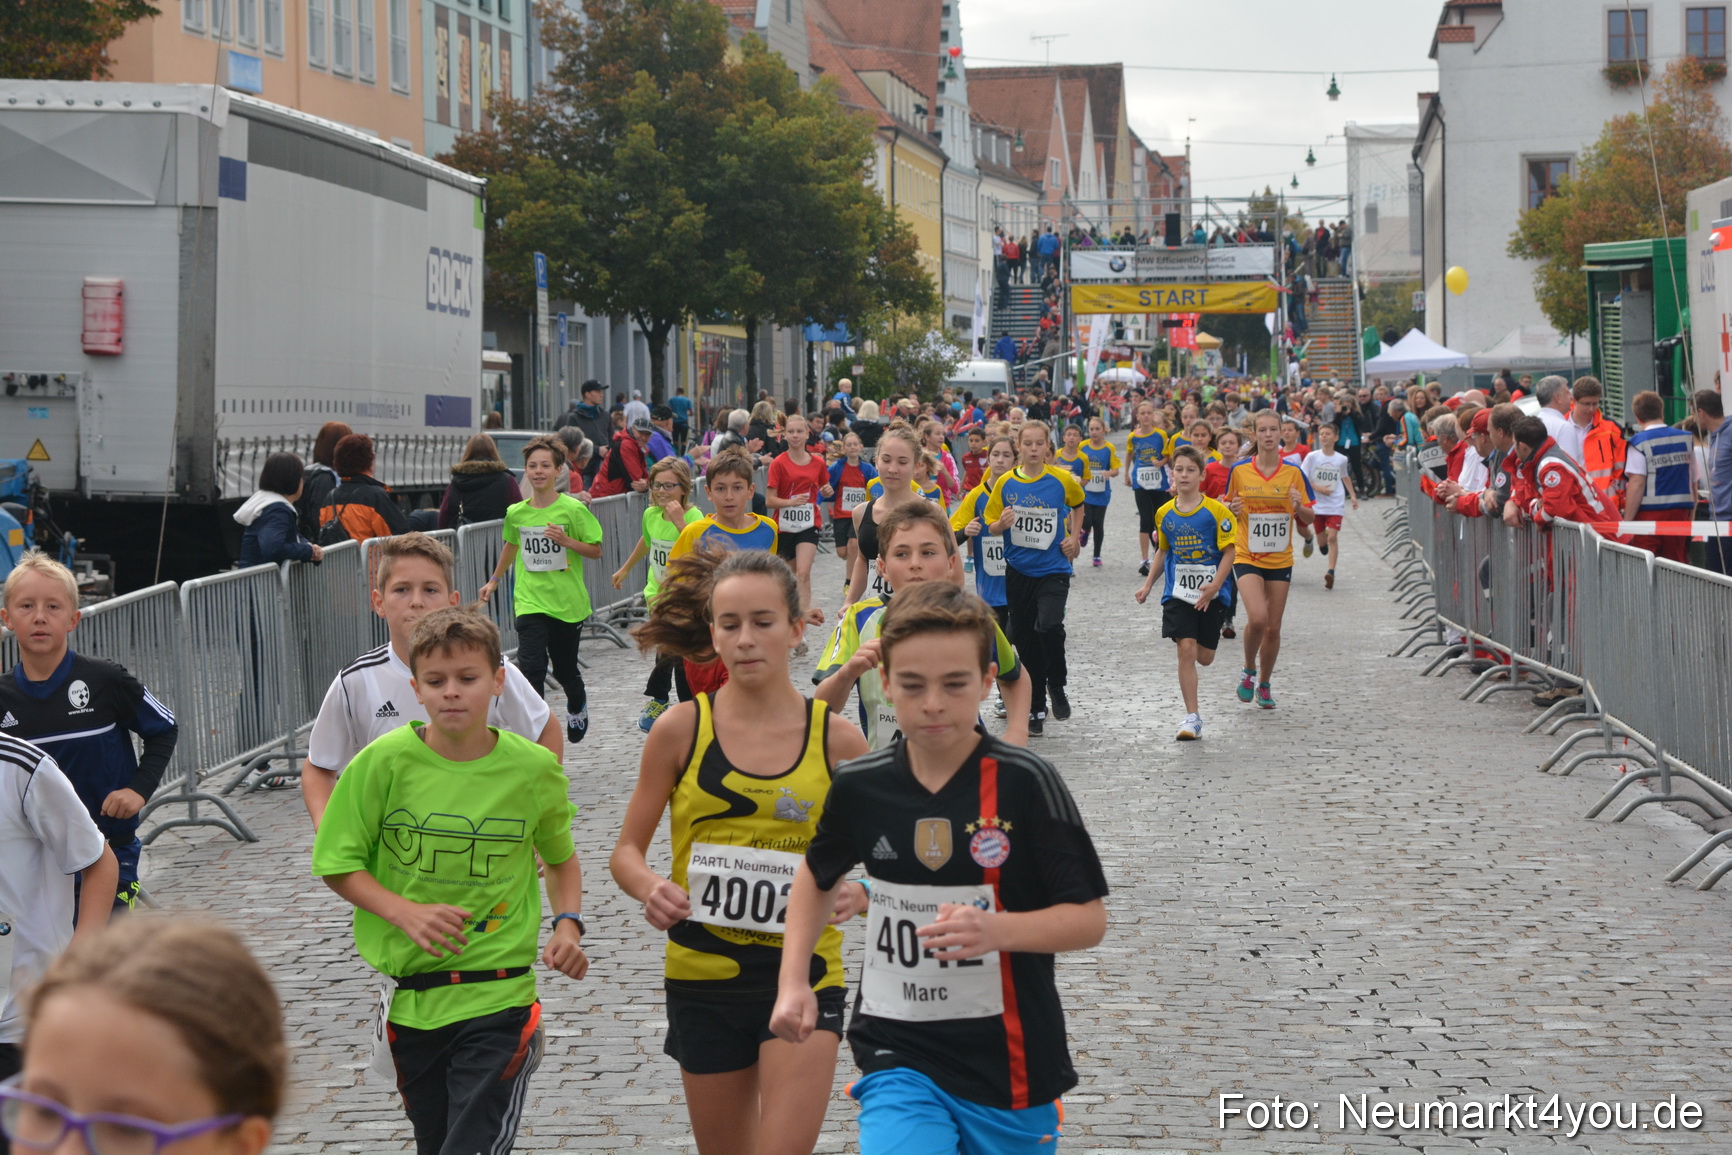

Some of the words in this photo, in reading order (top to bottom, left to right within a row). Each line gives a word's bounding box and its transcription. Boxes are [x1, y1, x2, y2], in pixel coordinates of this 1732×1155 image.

[426, 246, 473, 318] BOCK
[1138, 289, 1209, 306] START
[1140, 472, 1160, 481] 4010
[1316, 471, 1338, 481] 4004
[782, 509, 811, 521] 4008
[1015, 516, 1053, 534] 4035
[1252, 522, 1287, 537] 4015
[524, 538, 562, 554] 4038
[1025, 535, 1040, 543] Elisa
[654, 549, 671, 567] 40
[987, 546, 1004, 561] 40
[375, 710, 400, 718] adidas
[879, 713, 898, 724] PAR
[691, 855, 731, 869] PARTL
[733, 857, 795, 876] Neumarkt
[869, 893, 898, 910] ARTL
[902, 981, 948, 1002] Marc
